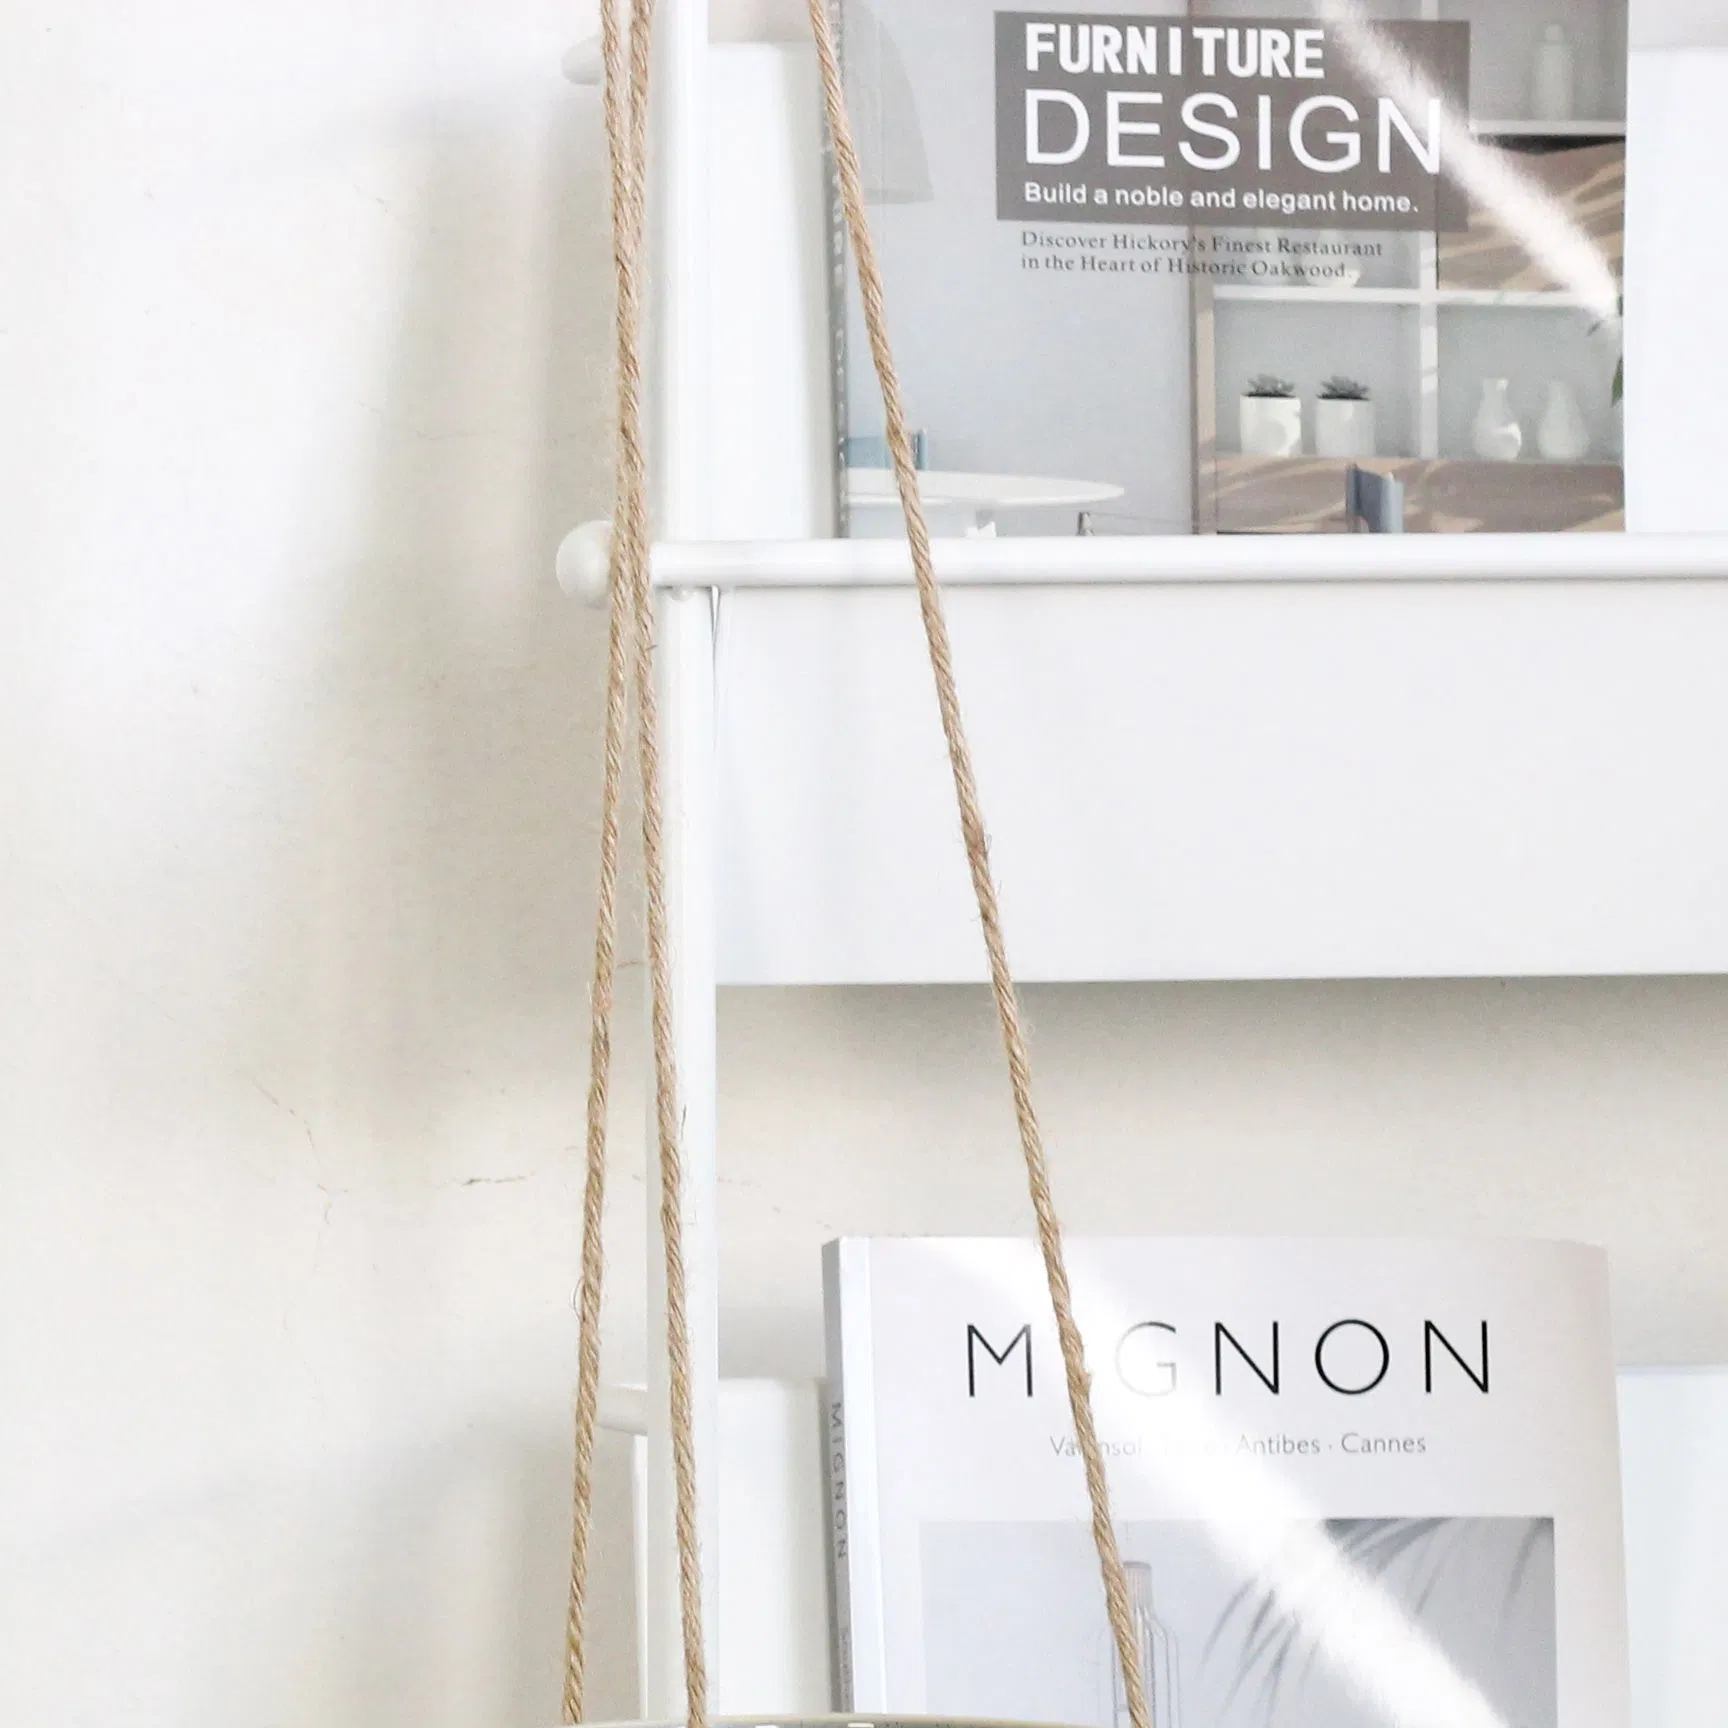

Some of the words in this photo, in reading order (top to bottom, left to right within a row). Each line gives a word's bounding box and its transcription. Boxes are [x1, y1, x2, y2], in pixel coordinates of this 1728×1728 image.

[1025, 22, 1325, 79] FURNITURE
[1025, 88, 1440, 174] DESIGN
[1024, 181, 1088, 204] Build
[1094, 187, 1109, 205] a
[1115, 184, 1184, 208] noble
[1190, 187, 1236, 209] and
[1242, 187, 1337, 215] elegant
[1342, 190, 1419, 213] home.
[1022, 230, 1108, 249] Discover
[1113, 233, 1205, 255] Hickory's
[1212, 235, 1272, 253] Finest
[1277, 237, 1383, 257] Restaurant
[1022, 254, 1040, 270] in
[1045, 254, 1074, 271] the
[1080, 256, 1136, 273] Heart
[1141, 256, 1161, 274] of
[1167, 257, 1247, 276] Historic
[966, 1319, 1489, 1398] MGNON
[1235, 1434, 1321, 1455] Antibes
[1340, 1431, 1427, 1454] Cannes
